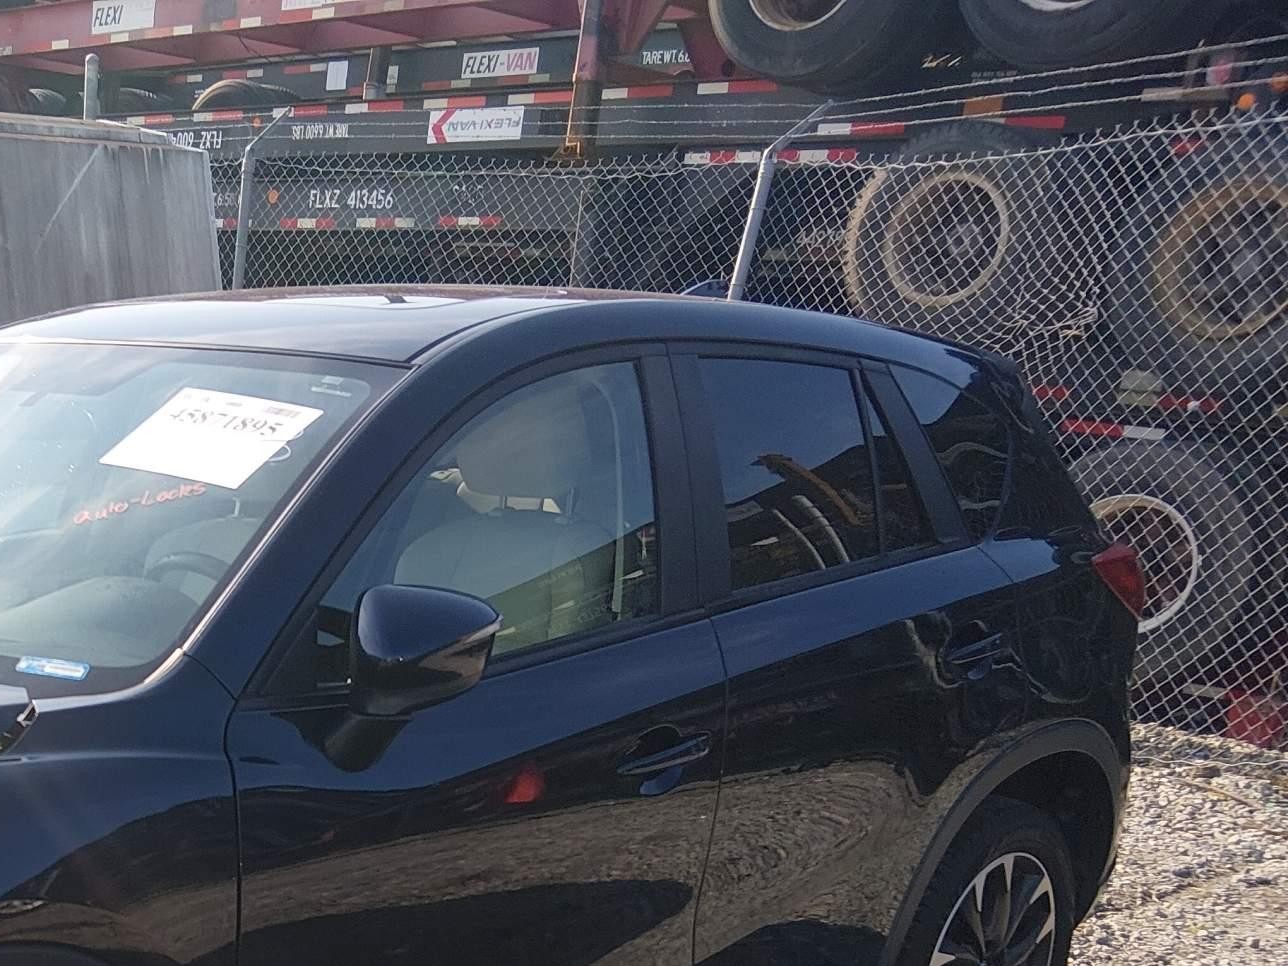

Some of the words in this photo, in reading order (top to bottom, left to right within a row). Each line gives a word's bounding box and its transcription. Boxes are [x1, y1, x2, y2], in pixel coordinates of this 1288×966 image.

[93, 5, 123, 28] FLEXI
[463, 51, 537, 75] FLEXI-VAN
[642, 50, 663, 65] TARE
[199, 130, 223, 150] FLXZ
[309, 189, 341, 209] FLXZ
[347, 189, 394, 209] 413456
